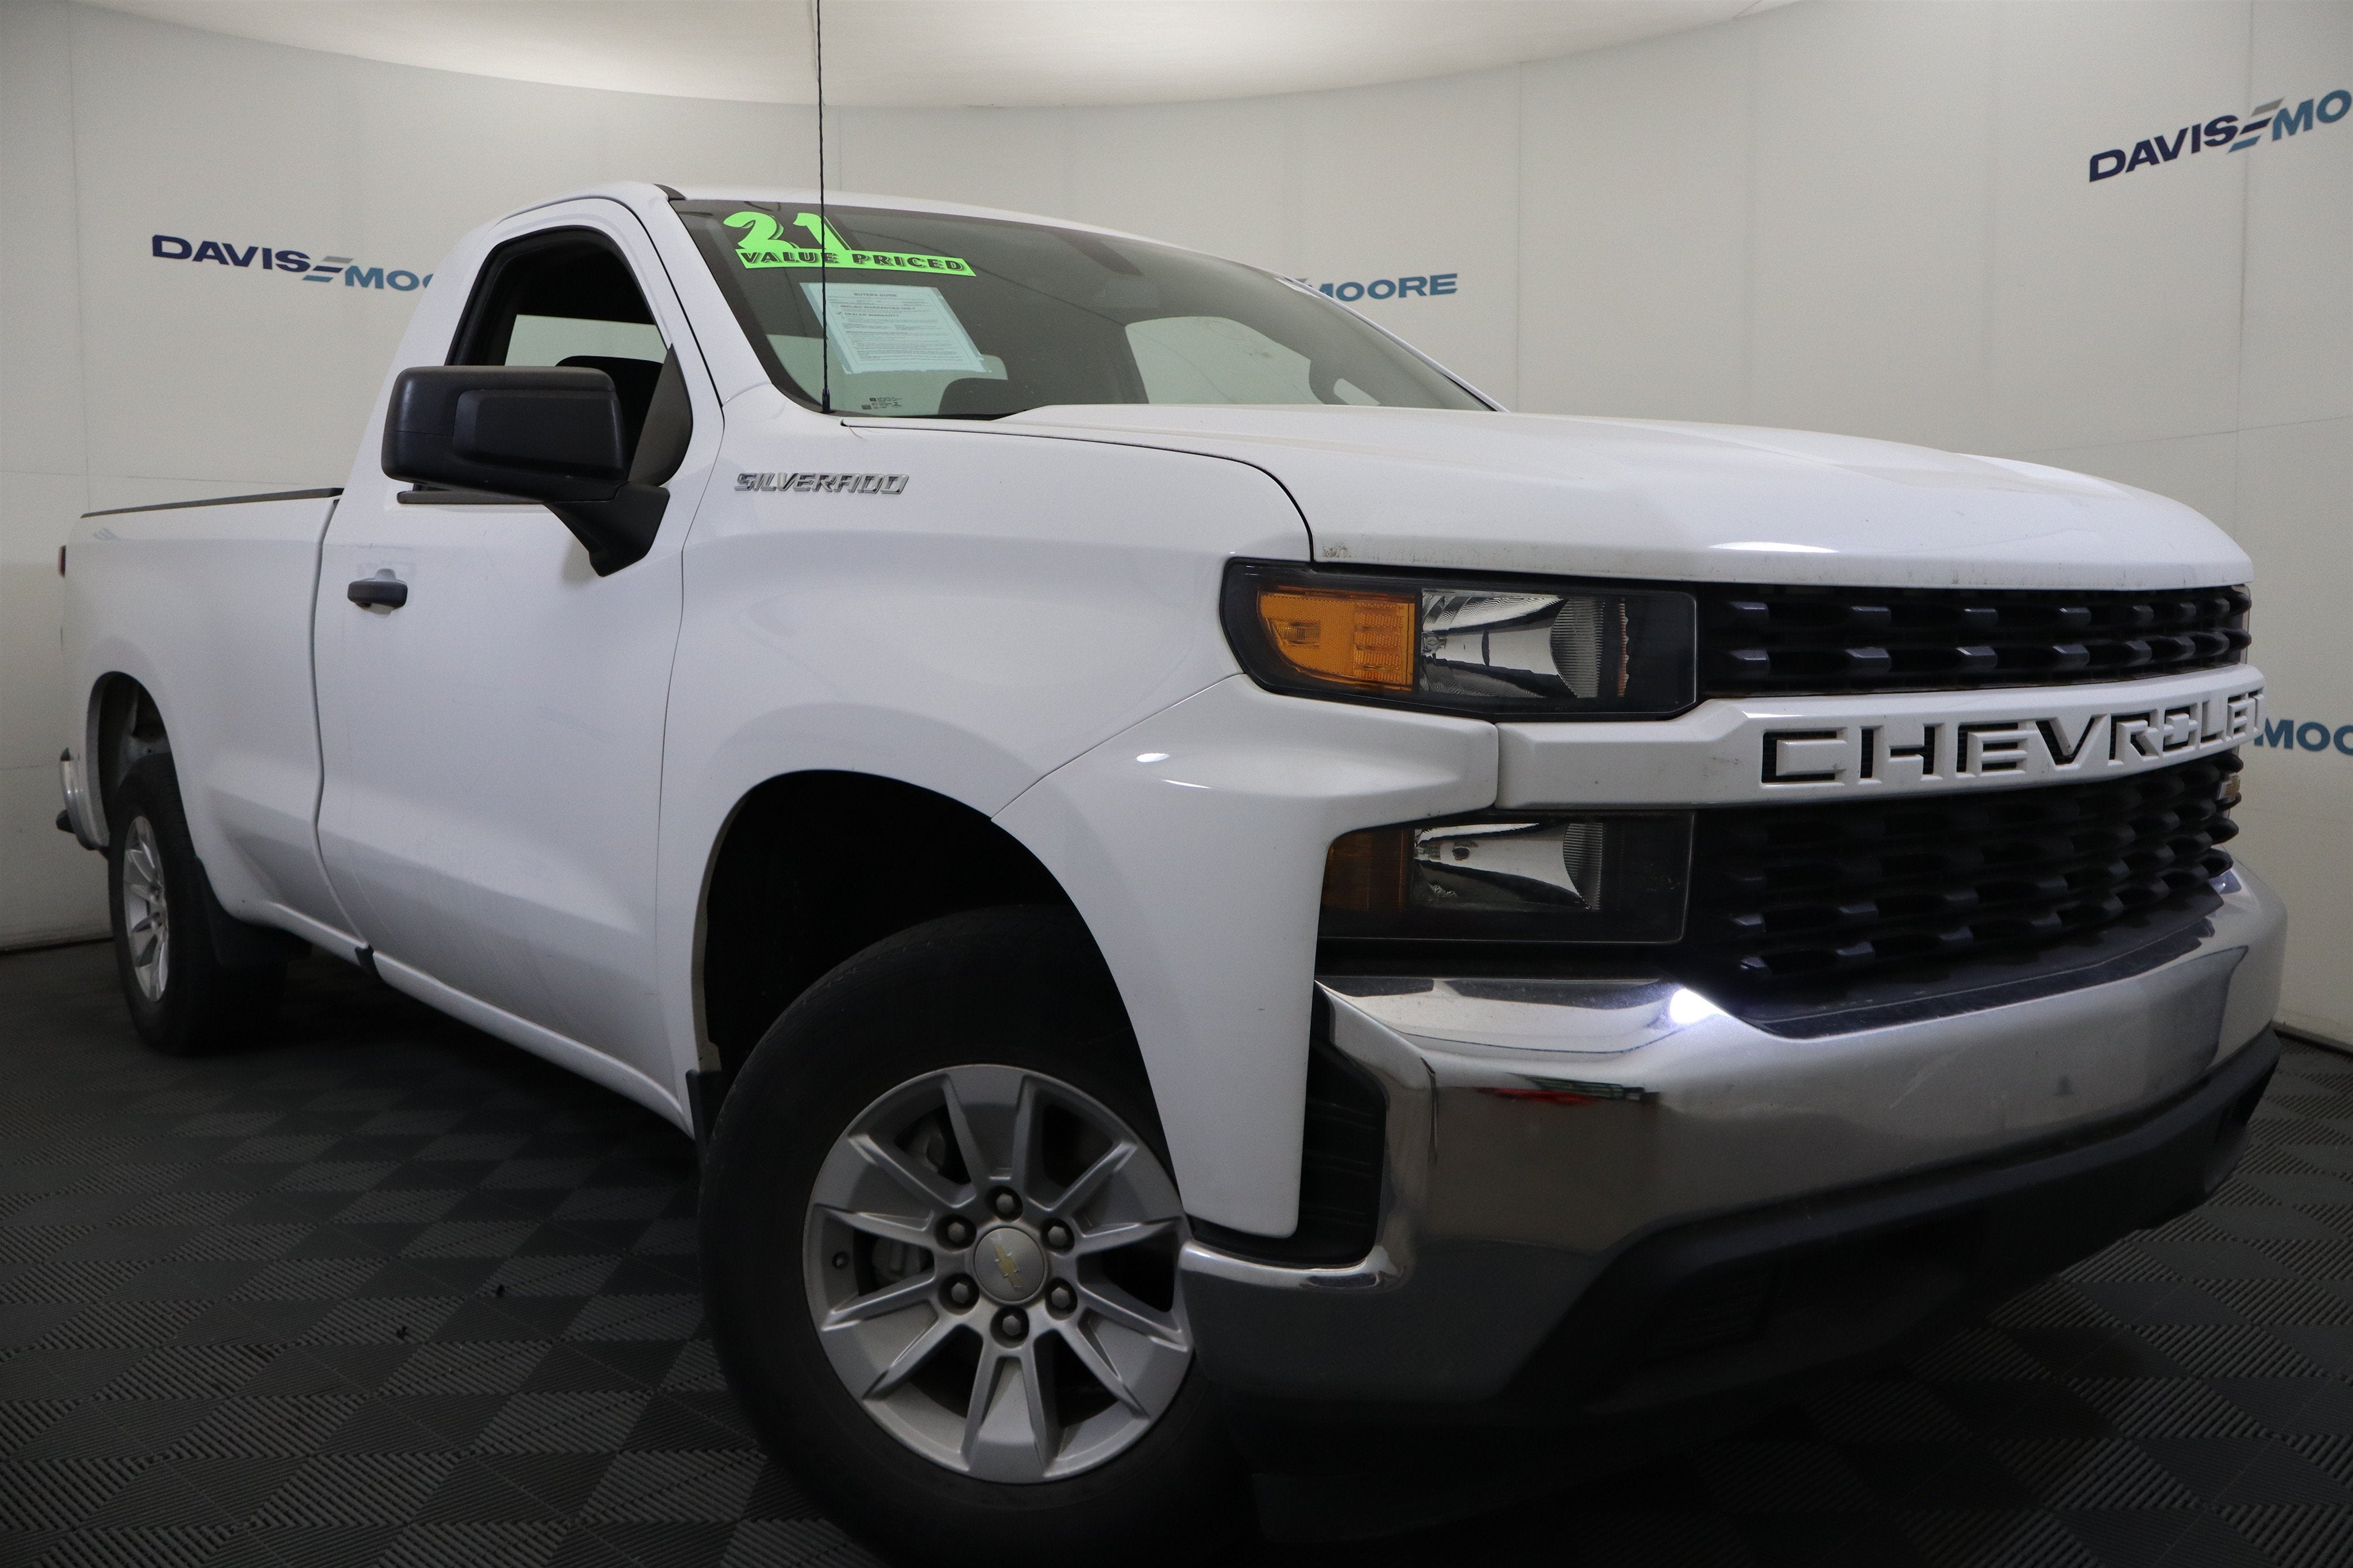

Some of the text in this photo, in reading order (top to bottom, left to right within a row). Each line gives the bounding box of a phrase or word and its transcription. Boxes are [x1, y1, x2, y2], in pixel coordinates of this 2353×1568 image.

[2089, 90, 2352, 182] DAVIS MO
[723, 211, 850, 250] 21
[152, 234, 434, 291] DAVIS MO
[740, 252, 963, 271] VALUE PRICED
[734, 472, 909, 495] SILVERADO
[1761, 687, 2264, 785] CHEVROLET
